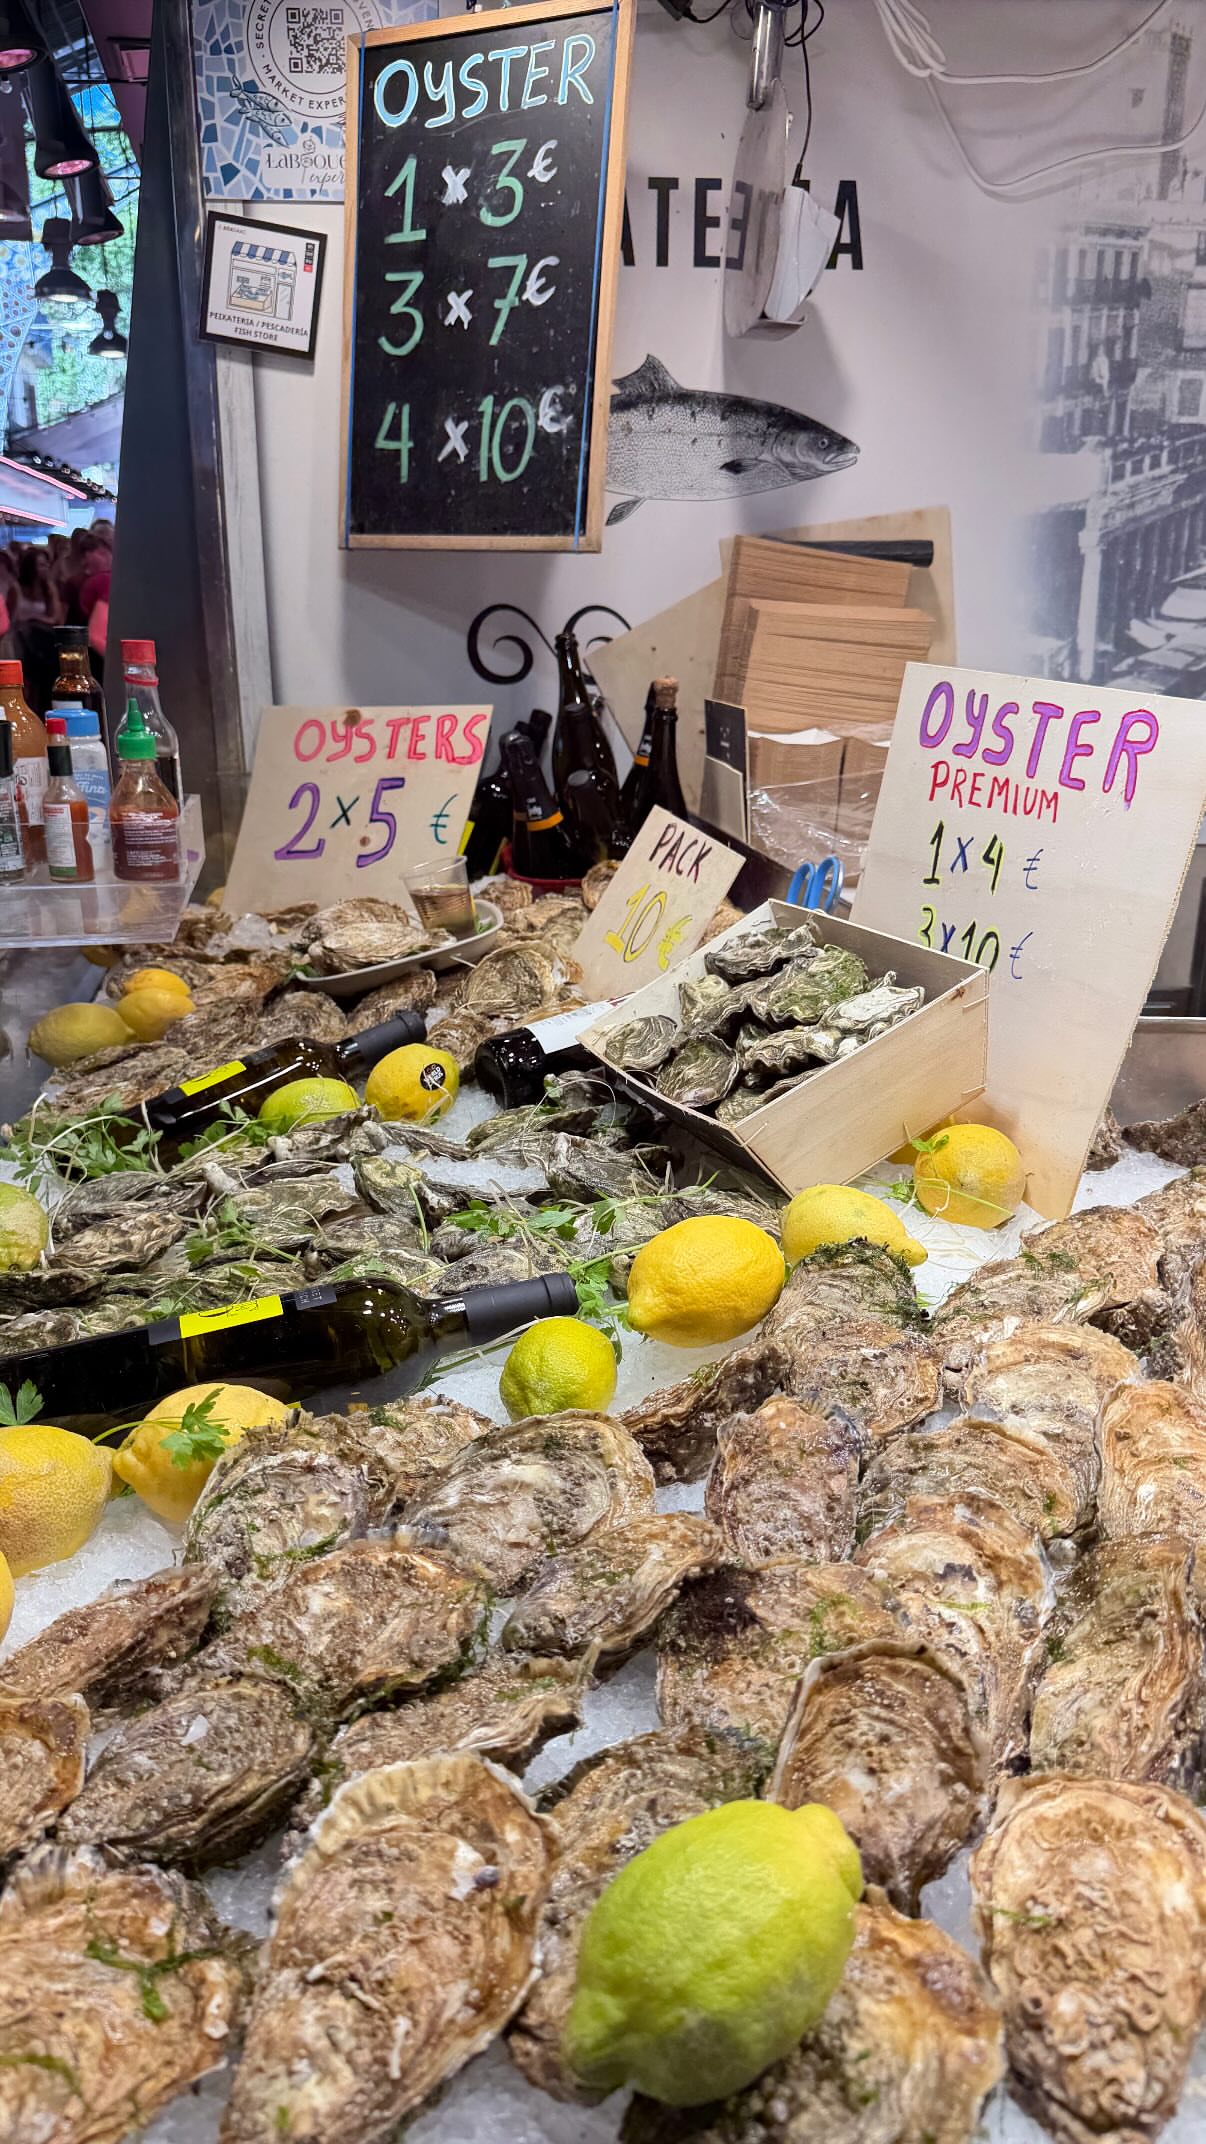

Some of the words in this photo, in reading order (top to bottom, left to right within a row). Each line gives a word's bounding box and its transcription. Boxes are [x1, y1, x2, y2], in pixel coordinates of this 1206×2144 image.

[262, 64, 304, 105] MARKET
[374, 34, 595, 128] OYSTER
[384, 153, 427, 244] 1
[234, 326, 252, 337] FISH
[254, 330, 278, 341] STORE
[378, 271, 424, 356] 3
[375, 402, 413, 483] 4
[294, 714, 487, 765] OYSTERS
[919, 681, 1159, 811] OYSTER
[929, 760, 1060, 823] PREMIUM
[649, 823, 712, 884] PACK
